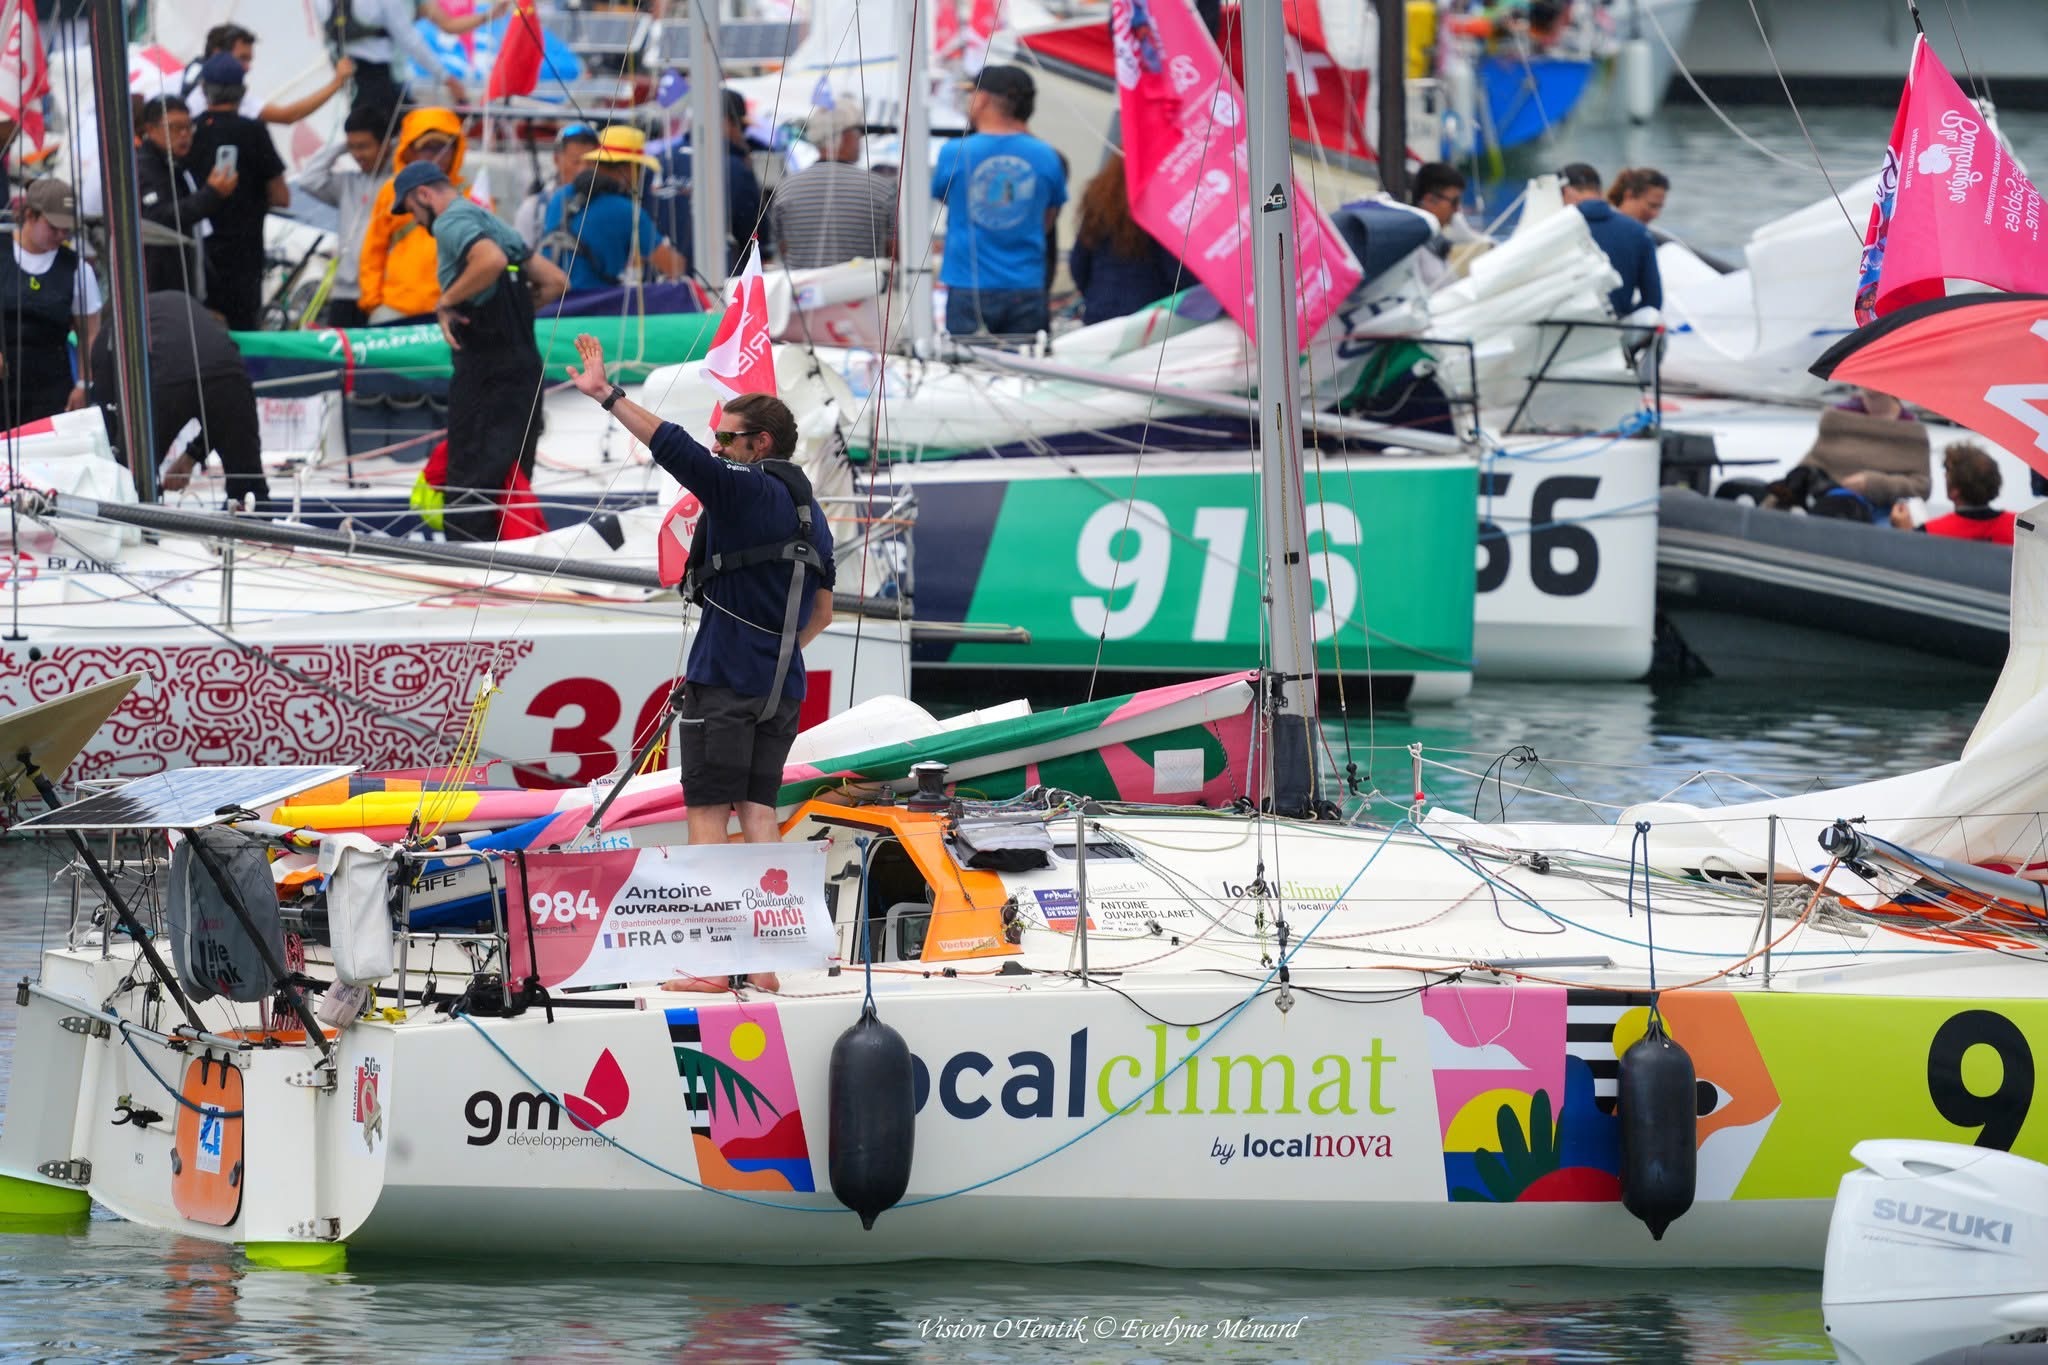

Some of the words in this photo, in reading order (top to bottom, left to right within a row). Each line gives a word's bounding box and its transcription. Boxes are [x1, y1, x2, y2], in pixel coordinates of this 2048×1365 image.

[625, 882, 712, 899] Antoine
[742, 888, 805, 912] Boulangère
[529, 889, 600, 925] 984
[614, 900, 742, 916] OUVRARD-LANET
[1100, 900, 1150, 910] ANTOINE
[1104, 909, 1195, 920] OUVRARD-LANET
[627, 930, 667, 947] FRA
[760, 926, 807, 937] transat
[1927, 1009, 2036, 1153] 9
[464, 1090, 560, 1146] gm
[507, 1131, 618, 1150] développement
[1210, 1136, 1236, 1165] by
[1243, 1131, 1394, 1158] localnova
[1873, 1198, 2013, 1245] SUZUKI
